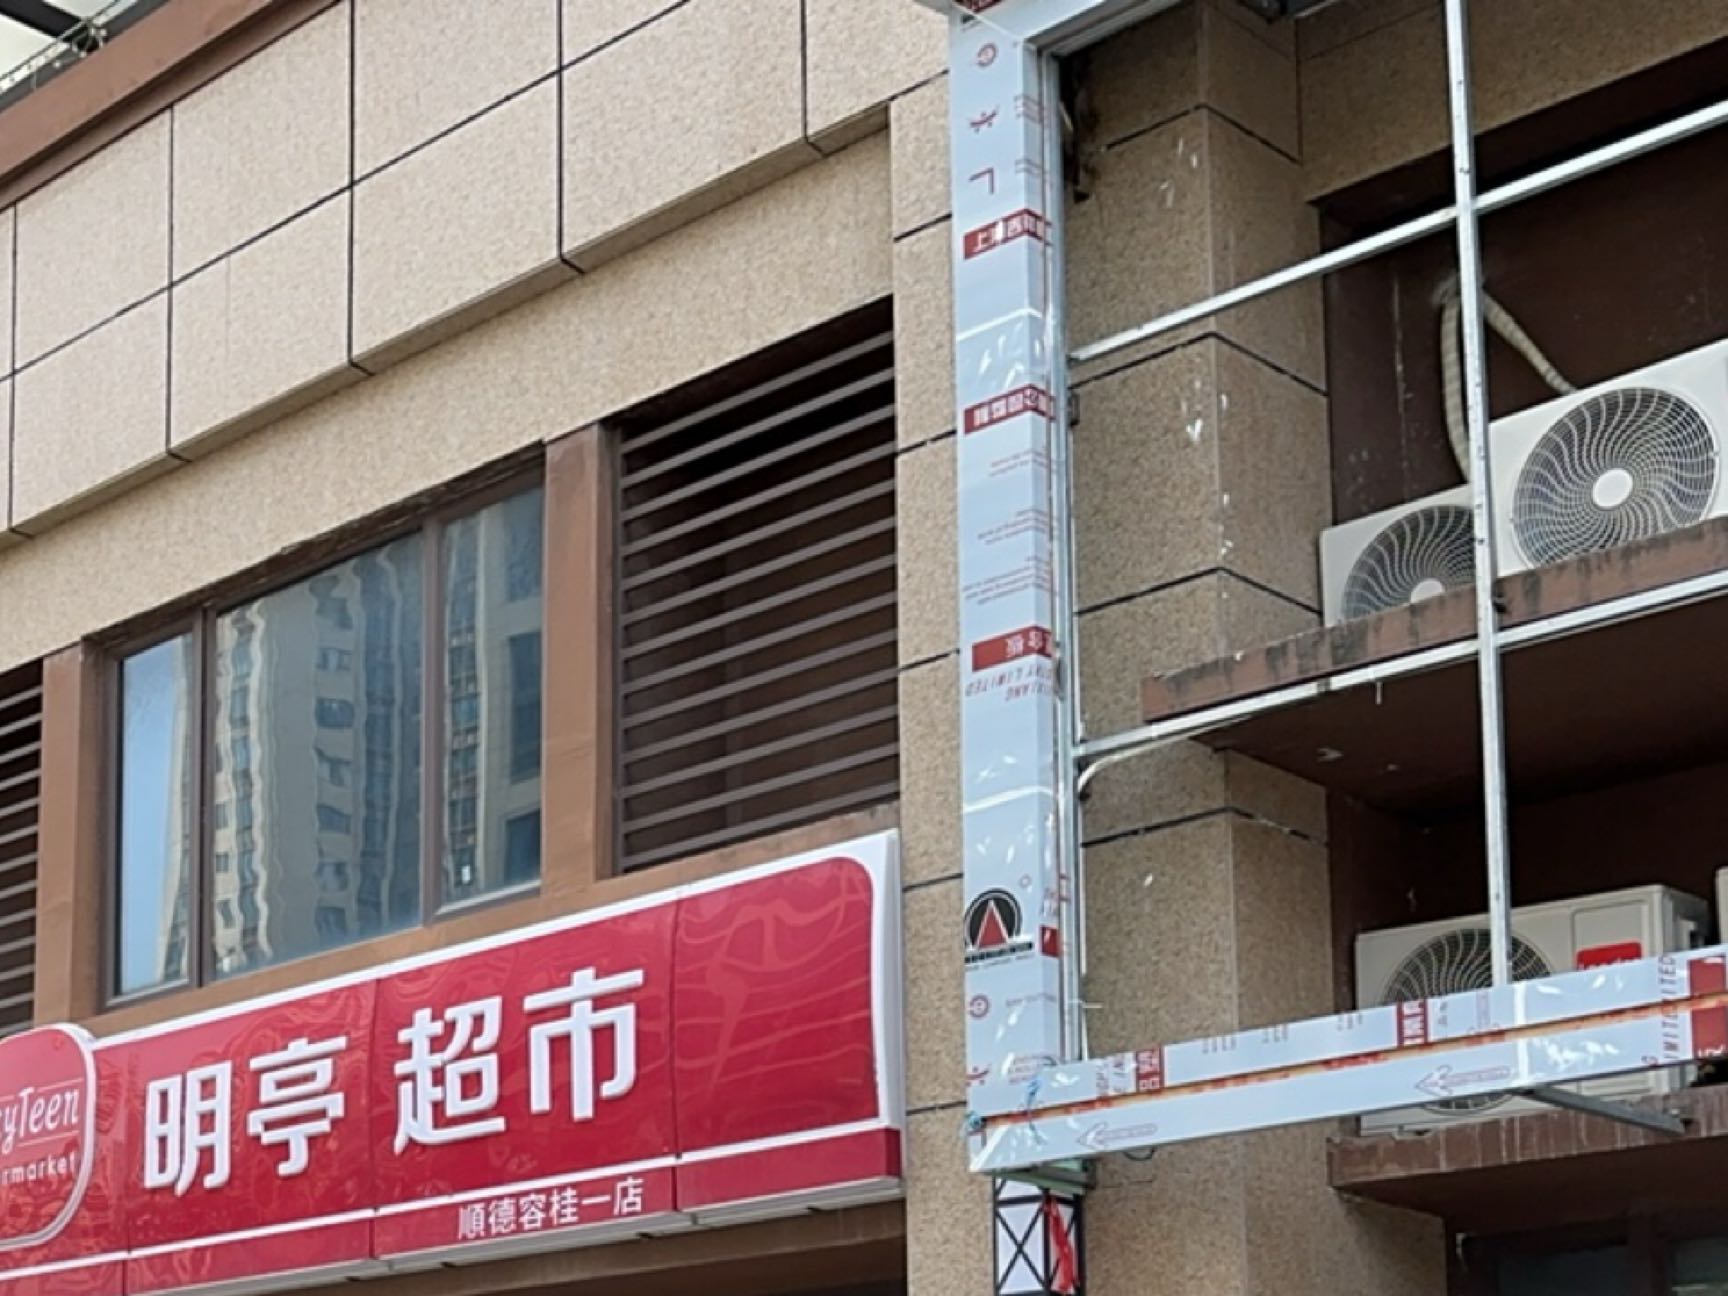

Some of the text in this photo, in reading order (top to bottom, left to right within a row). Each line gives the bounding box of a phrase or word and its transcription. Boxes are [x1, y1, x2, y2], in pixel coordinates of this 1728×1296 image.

[144, 966, 645, 1197] 明亭超市
[457, 1175, 644, 1241] 順德容桂一店
